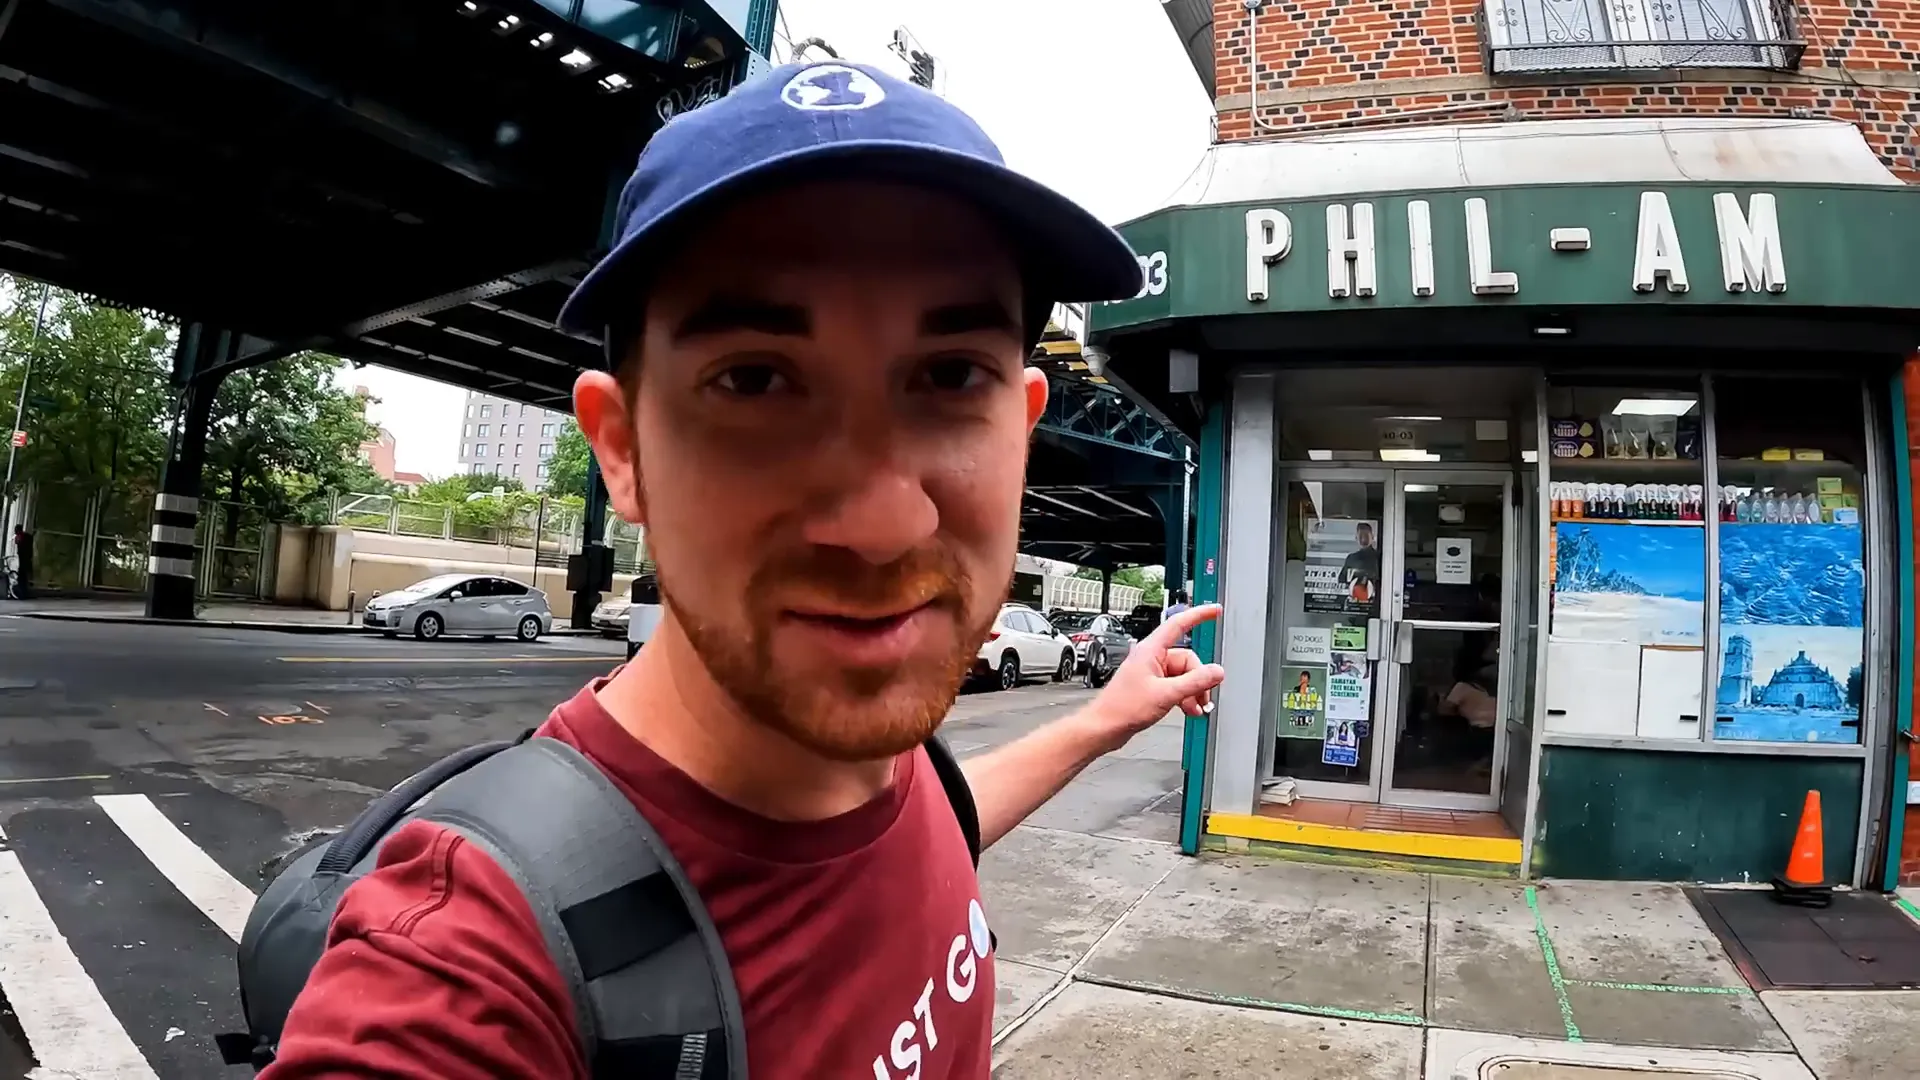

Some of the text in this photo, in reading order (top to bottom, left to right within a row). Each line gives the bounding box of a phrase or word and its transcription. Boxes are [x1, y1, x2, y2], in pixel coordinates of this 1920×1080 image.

[1304, 635, 1324, 643] DOGS
[1291, 646, 1325, 654] ALLOWED
[873, 977, 939, 1080] ST
